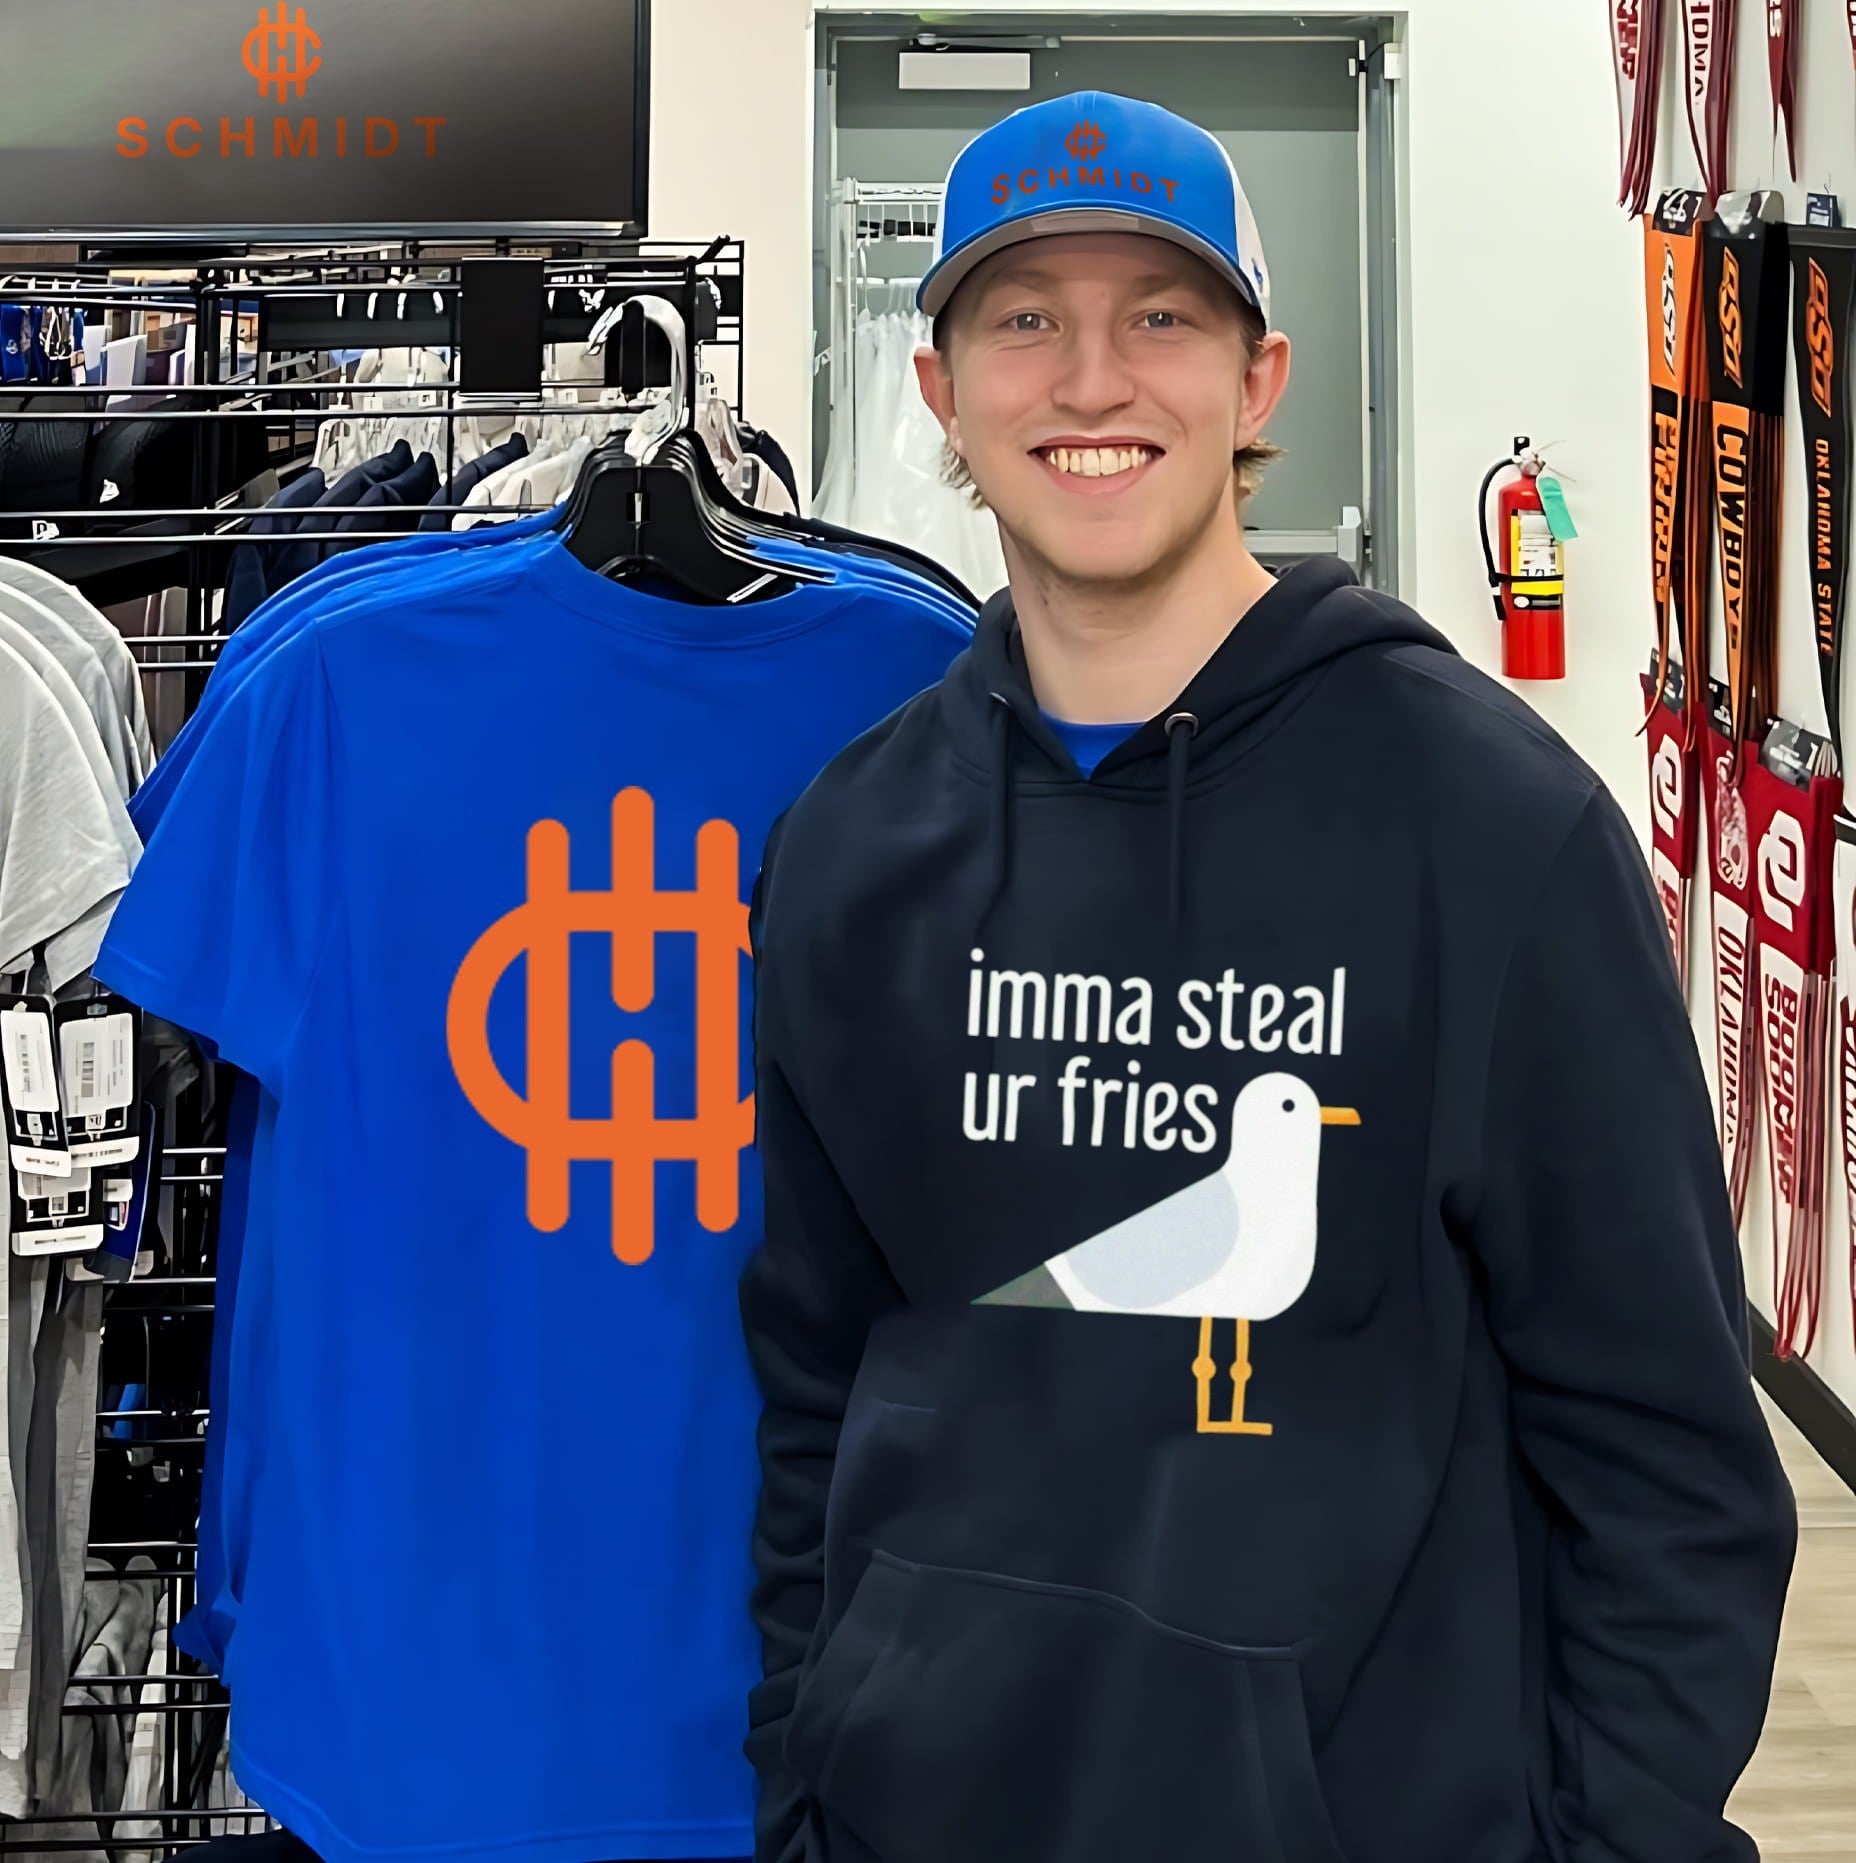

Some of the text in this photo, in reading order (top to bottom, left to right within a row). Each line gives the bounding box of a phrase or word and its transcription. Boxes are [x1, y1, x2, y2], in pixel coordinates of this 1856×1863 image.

[116, 117, 447, 158] SCHMIDT
[991, 167, 1179, 204] SCHMIDT
[967, 947, 1346, 1056] imma steal
[962, 1055, 1219, 1153] ur fries
